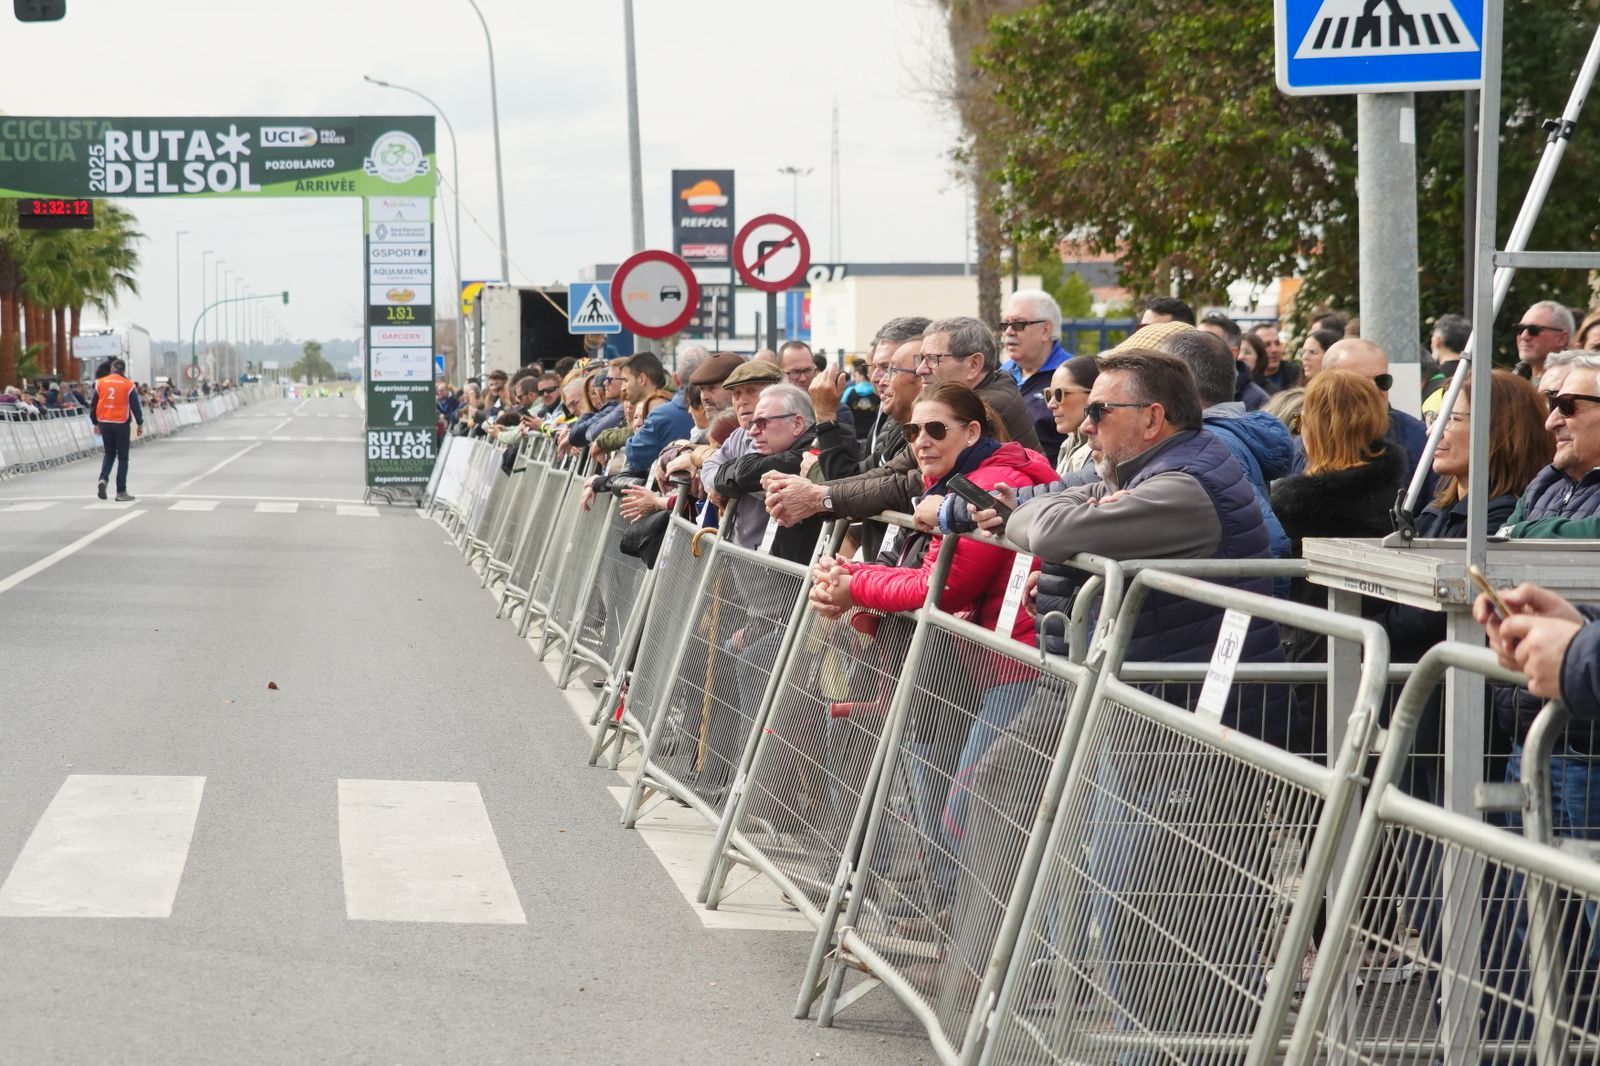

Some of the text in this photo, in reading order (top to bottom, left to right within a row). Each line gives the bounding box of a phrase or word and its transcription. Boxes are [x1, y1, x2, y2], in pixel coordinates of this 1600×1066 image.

[2, 119, 113, 140] CICLISTA
[265, 131, 295, 143] UCI
[89, 144, 105, 192] 2025
[265, 159, 335, 170] POZOBLANCO
[33, 200, 88, 215] 3:32:12
[681, 217, 729, 228] REPSOL
[372, 248, 417, 258] GSPORT
[373, 268, 428, 276] AQUAMARINA
[107, 388, 115, 399] 2
[391, 400, 414, 422] 71
[368, 431, 416, 446] RUTA
[1359, 580, 1385, 595] GUIL
